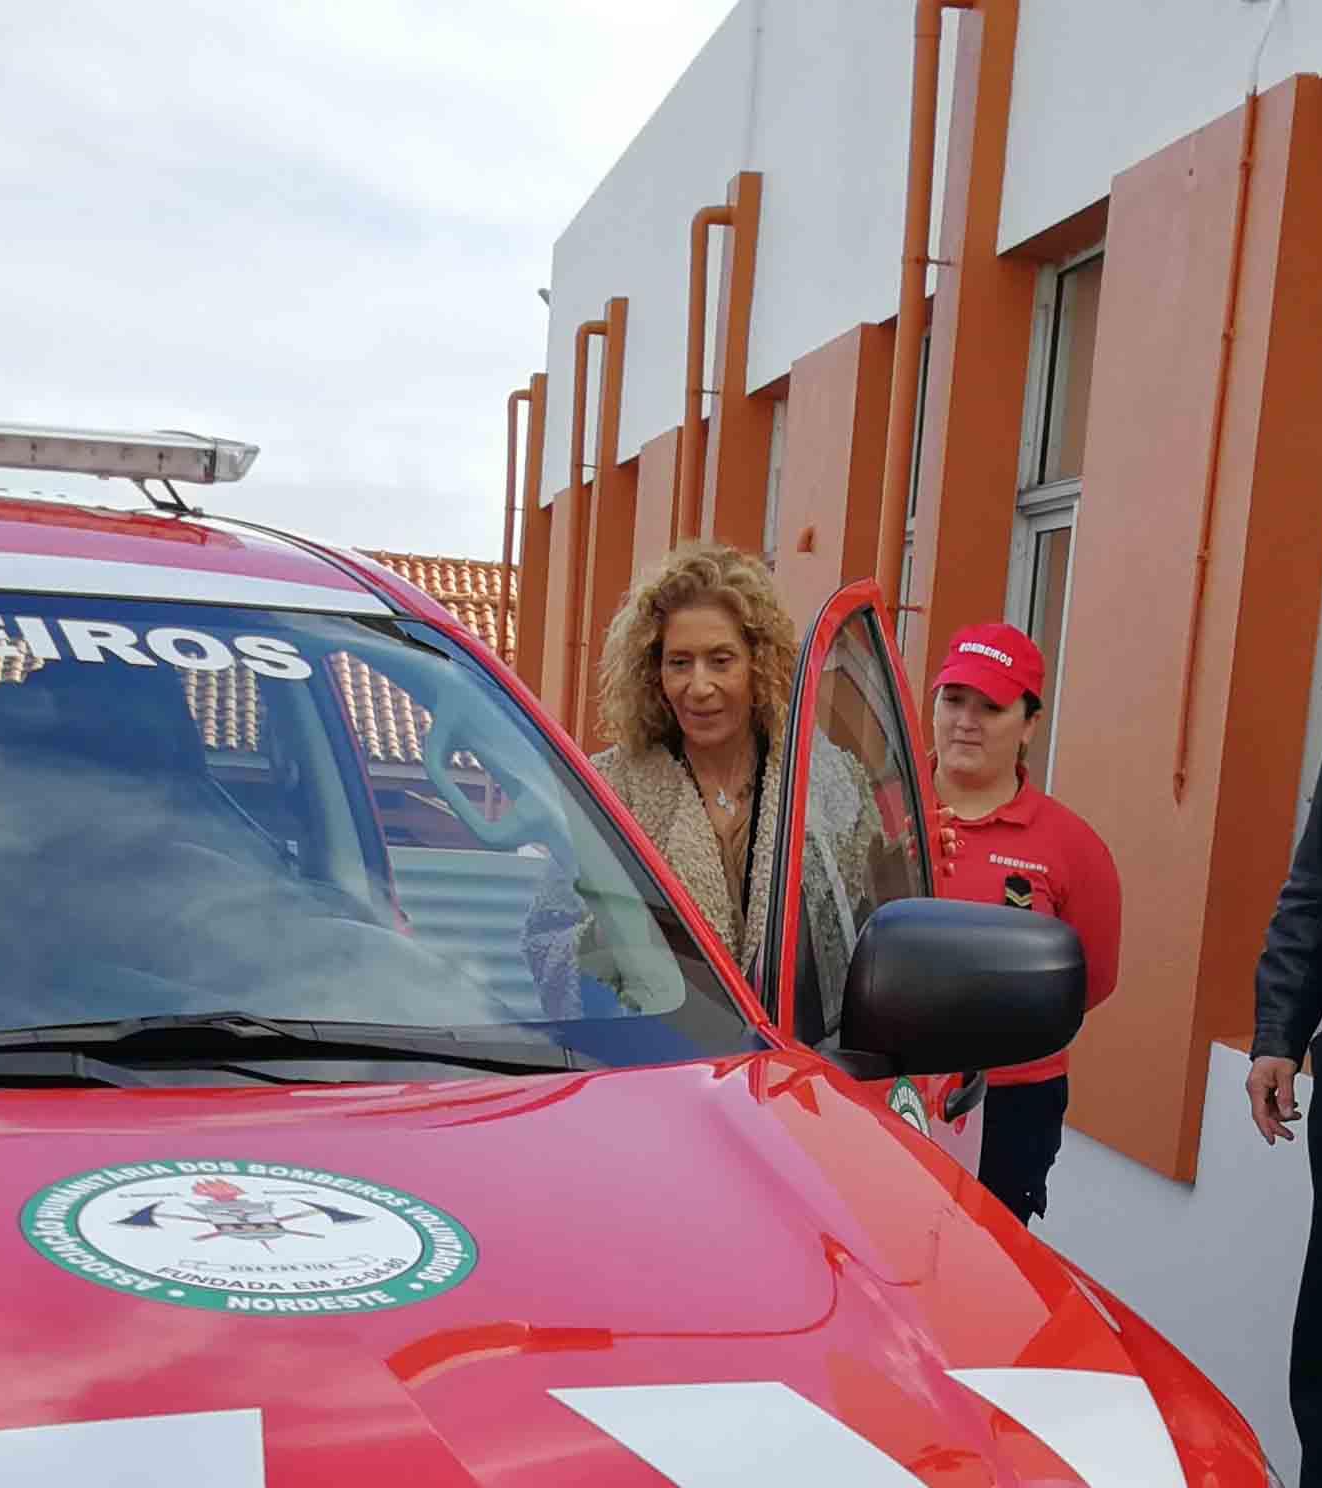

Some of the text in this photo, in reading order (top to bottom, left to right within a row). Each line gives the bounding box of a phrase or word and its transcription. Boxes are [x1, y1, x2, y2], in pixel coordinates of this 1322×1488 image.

[175, 1160, 240, 1174] DOS
[247, 1163, 411, 1207] BOMBEIROS
[156, 1265, 284, 1291] FUNDADA
[292, 1280, 332, 1291] EM
[227, 1289, 397, 1312] NORDESTE
